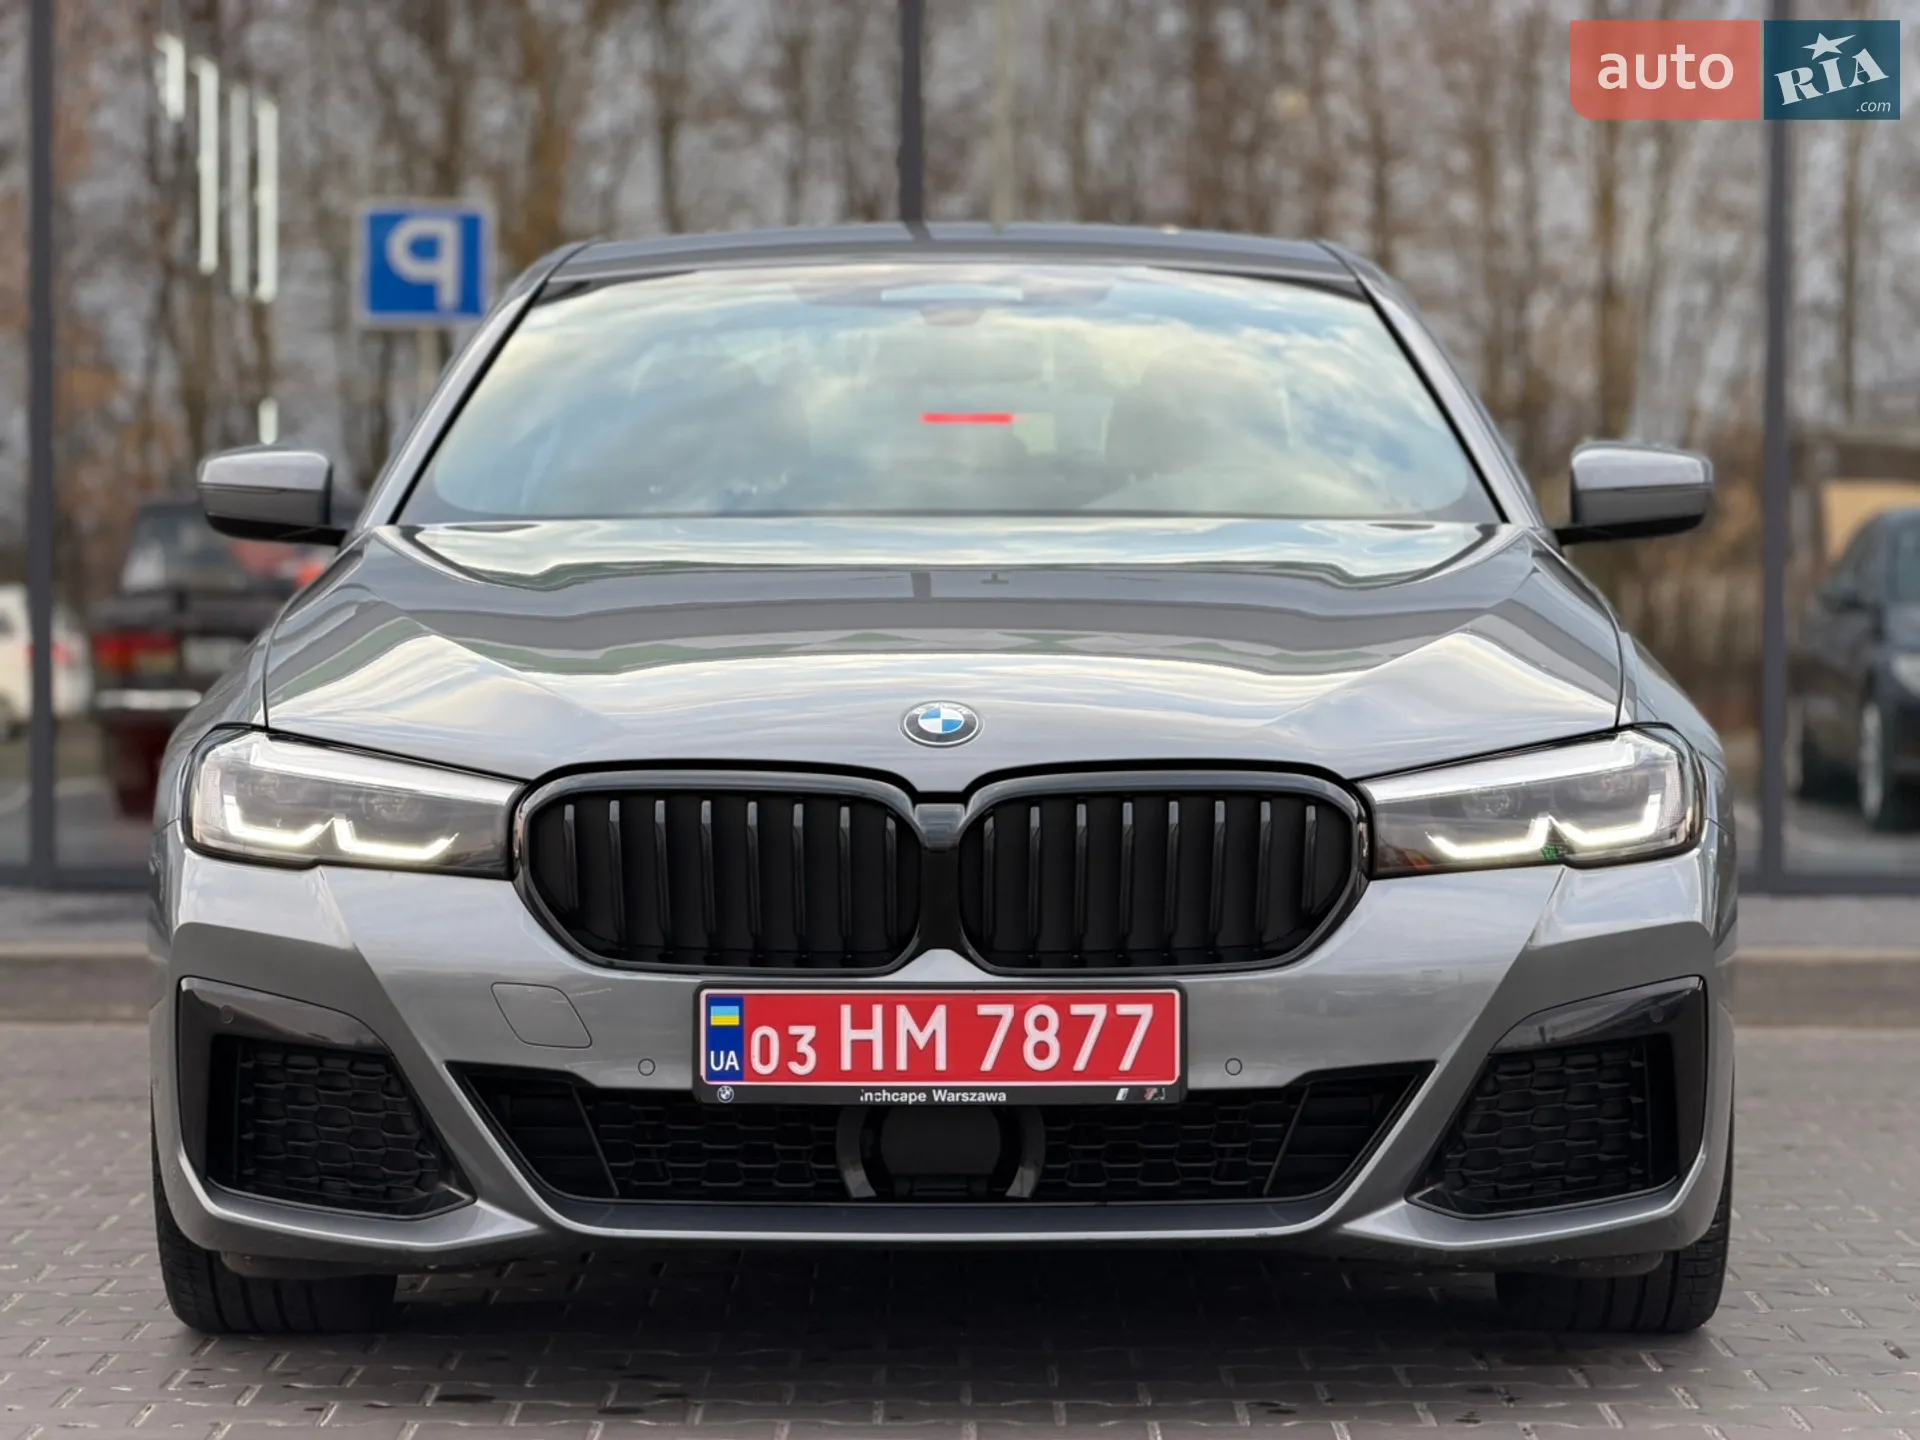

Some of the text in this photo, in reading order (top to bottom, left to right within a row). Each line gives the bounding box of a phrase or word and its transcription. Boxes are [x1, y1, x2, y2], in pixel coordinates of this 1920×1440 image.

[750, 1004, 1154, 1075] 03 HM 7877
[710, 1050, 740, 1071] UA
[932, 1089, 1007, 1102] Warszawa
